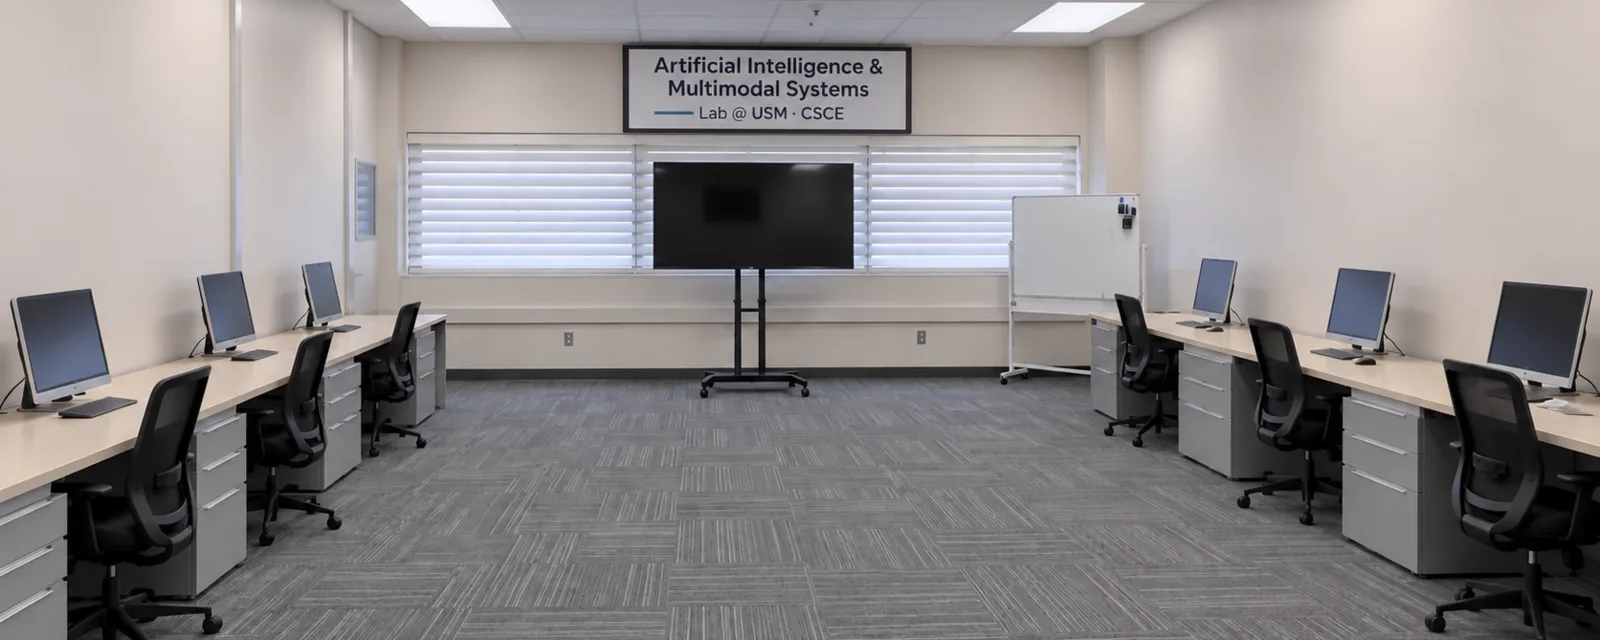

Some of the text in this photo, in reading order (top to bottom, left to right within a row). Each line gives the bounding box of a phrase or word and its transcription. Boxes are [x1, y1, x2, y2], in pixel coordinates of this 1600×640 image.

[654, 57, 883, 78] Artificial Intelligence &
[668, 79, 869, 100] Multimodal Systems
[699, 106, 727, 120] Lab
[732, 107, 747, 122] @
[752, 106, 787, 120] USM
[801, 106, 844, 120] CSCE
